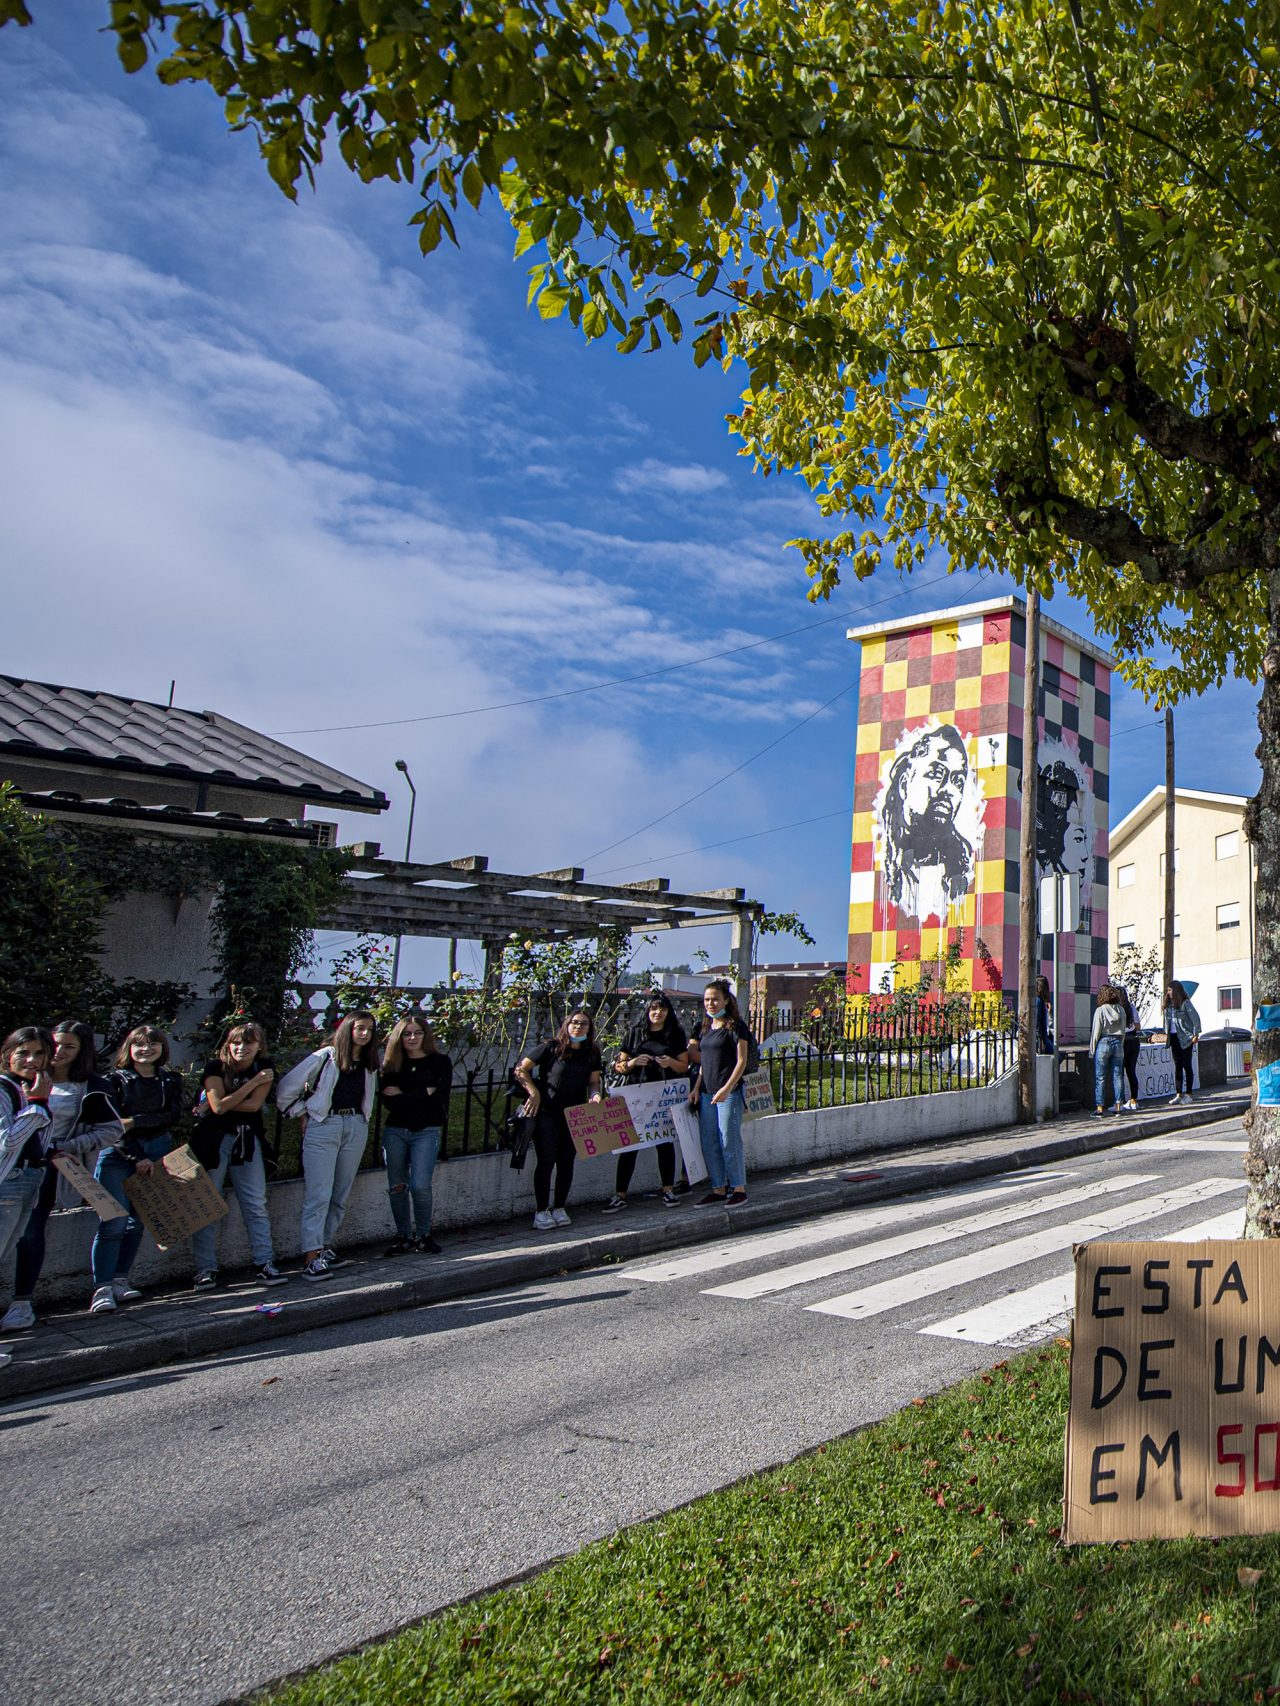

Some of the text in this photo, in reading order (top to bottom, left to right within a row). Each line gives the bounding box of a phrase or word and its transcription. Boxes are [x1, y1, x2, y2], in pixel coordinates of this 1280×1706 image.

[662, 1082, 687, 1097] NÃO
[605, 1098, 620, 1109] NÃO
[569, 1106, 585, 1118] NÃO
[603, 1107, 629, 1120] EXISTE
[568, 1115, 597, 1128] EXISTE
[605, 1120, 634, 1134] PLANETA
[644, 1121, 659, 1130] NÃO
[571, 1126, 599, 1139] PLANO
[619, 1131, 631, 1146] B
[584, 1138, 597, 1156] B
[1092, 1260, 1249, 1319] ESTA
[1091, 1338, 1175, 1410] DE
[1089, 1430, 1183, 1505] EM
